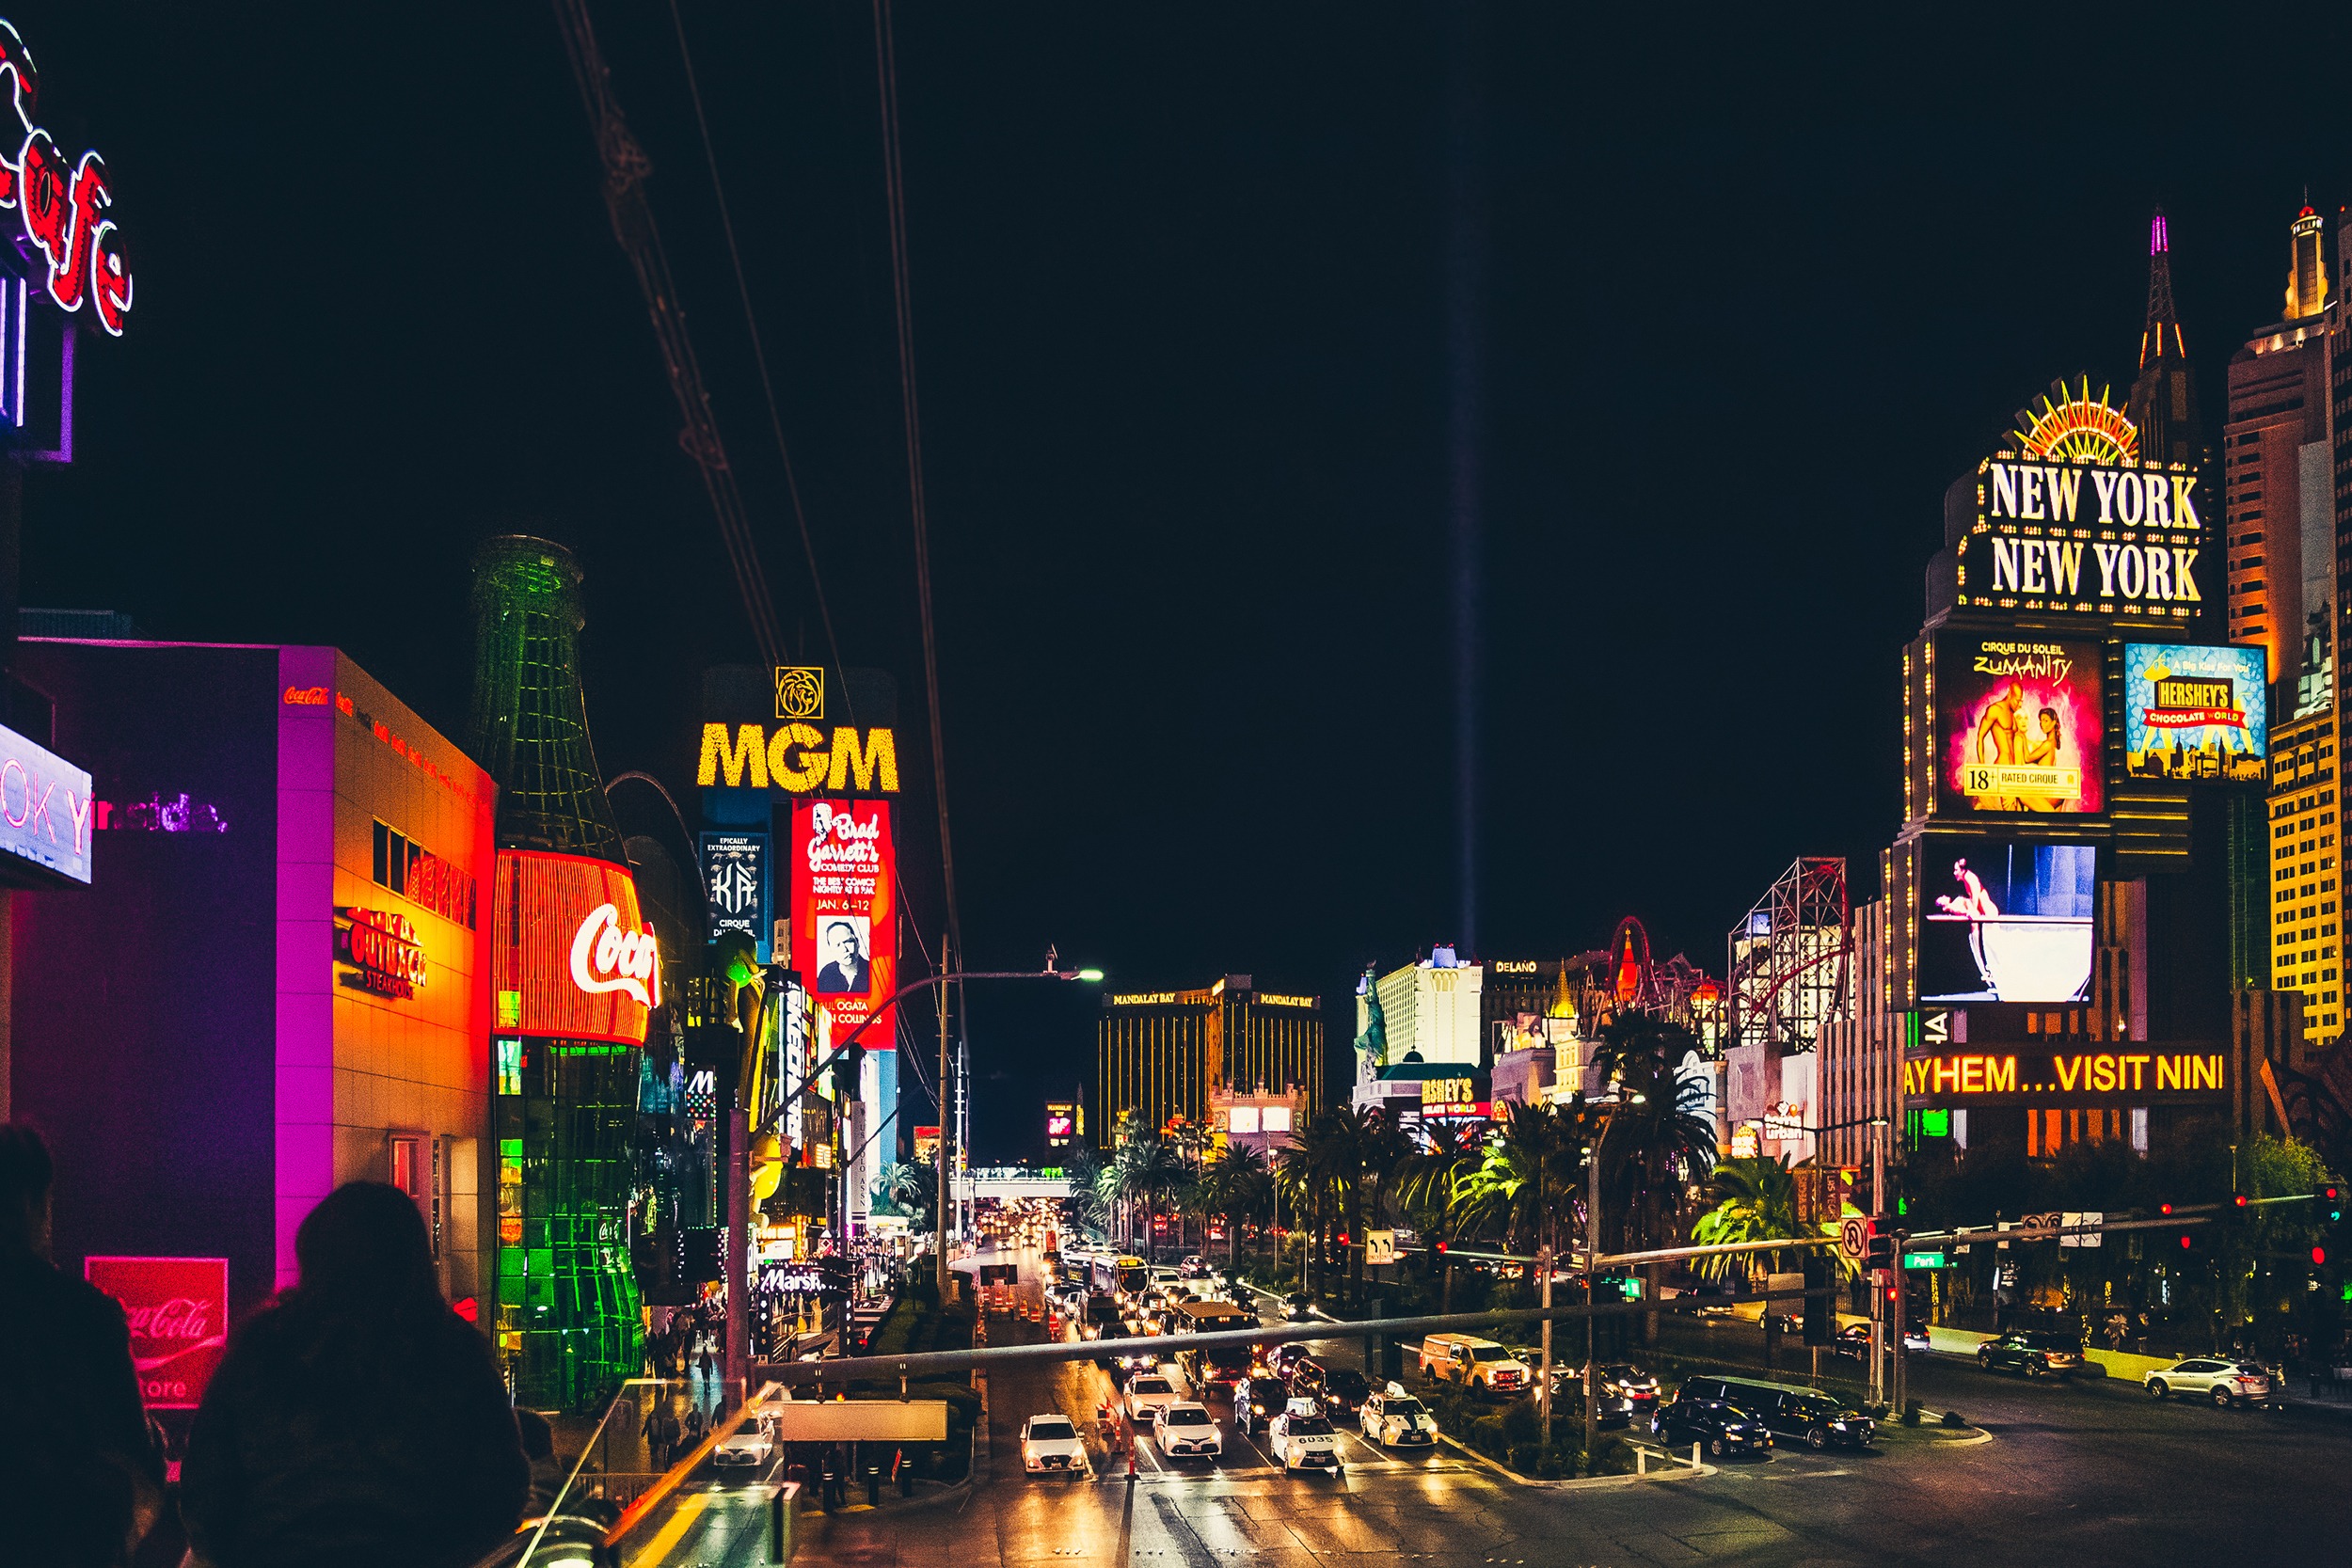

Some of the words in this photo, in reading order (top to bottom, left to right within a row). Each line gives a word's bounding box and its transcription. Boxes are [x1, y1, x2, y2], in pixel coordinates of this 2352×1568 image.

[1991, 464, 2083, 522] NEW
[2090, 469, 2201, 530] YORK
[1991, 537, 2085, 595] NEW
[2092, 544, 2201, 602] YORK
[1981, 641, 2015, 656] CIRQUE
[2017, 643, 2031, 654] DU
[2032, 644, 2064, 656] SOLEIL
[1974, 655, 2073, 688] ZUMANITY
[2160, 682, 2229, 708] HERSHEY'S
[2150, 712, 2205, 723] CHOCOLATE
[2207, 711, 2239, 722] WORLD
[696, 722, 900, 793] MGM
[2001, 772, 2027, 784] RATED
[2029, 773, 2058, 784] CIRQUE
[831, 813, 880, 840] Brad
[807, 833, 880, 873] Garrett's
[820, 863, 856, 873] COMEDY
[857, 864, 880, 873] CLUB
[813, 877, 826, 885] THE
[845, 878, 876, 886] COMICS
[817, 899, 839, 911] JAN.
[719, 920, 750, 929] CIRQUE
[351, 923, 428, 987] OUTBACK
[1496, 960, 1537, 974] DELANO
[1113, 993, 1158, 1006] MANDALAY
[1159, 992, 1176, 1004] BAY
[1260, 993, 1299, 1006] MANDALAY
[1299, 997, 1312, 1007] BAY
[819, 1002, 835, 1011] AUL
[837, 1002, 868, 1011] OGATA
[688, 1070, 714, 1093] M
[1446, 1103, 1477, 1114] WORLD
[1913, 1256, 1935, 1267] Park
[760, 1269, 822, 1292] Marsh
[1298, 1436, 1334, 1445] 6035
